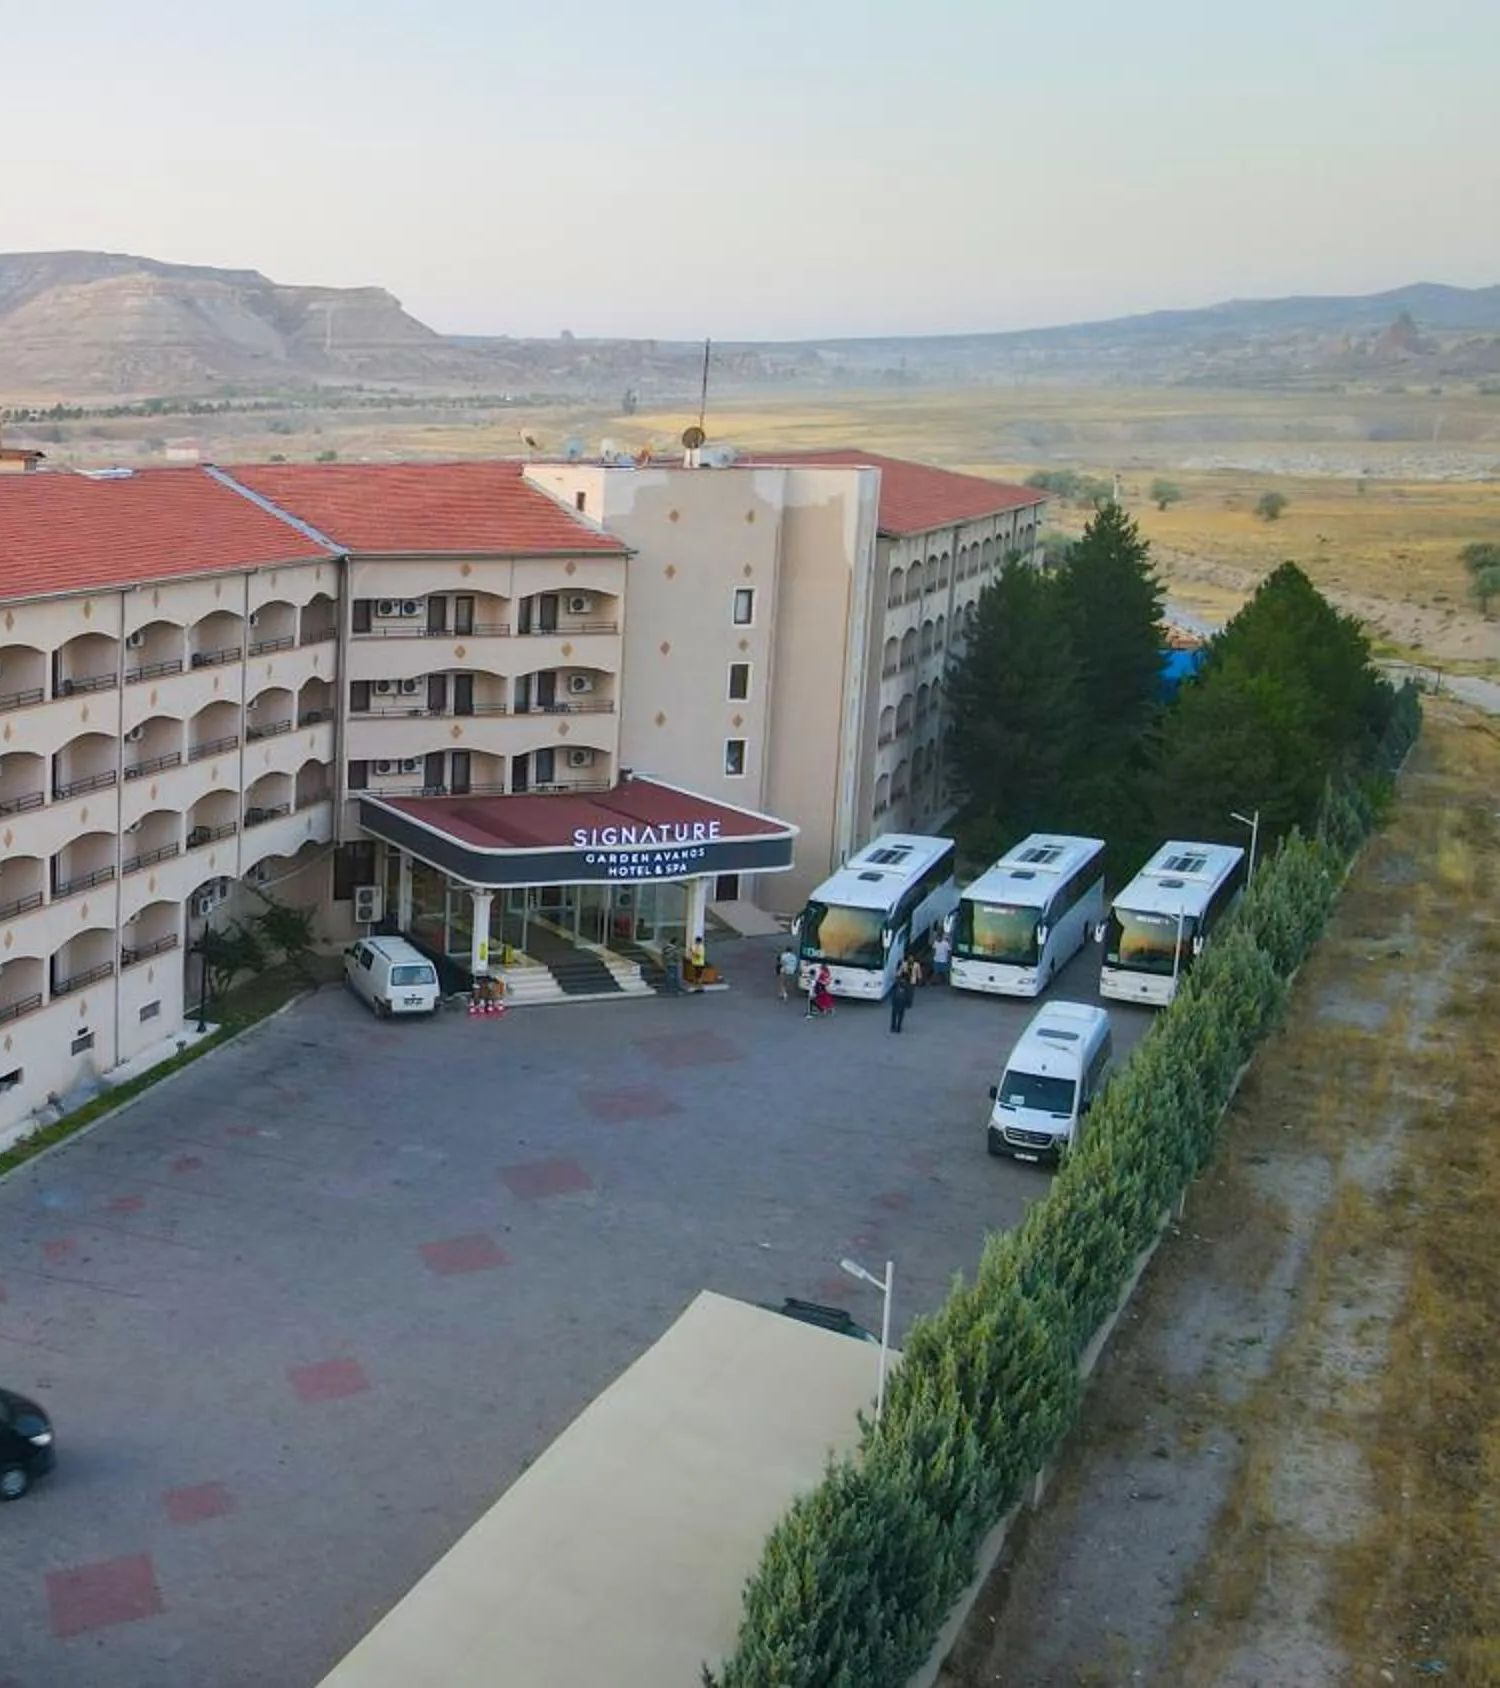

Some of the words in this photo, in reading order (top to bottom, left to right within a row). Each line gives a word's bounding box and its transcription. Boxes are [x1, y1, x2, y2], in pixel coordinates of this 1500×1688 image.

[573, 821, 722, 848] SIGNATURE
[585, 853, 649, 864] GARDEN
[654, 848, 705, 863] AVANOS
[608, 865, 652, 876] HOTEL
[665, 863, 687, 873] SPA
